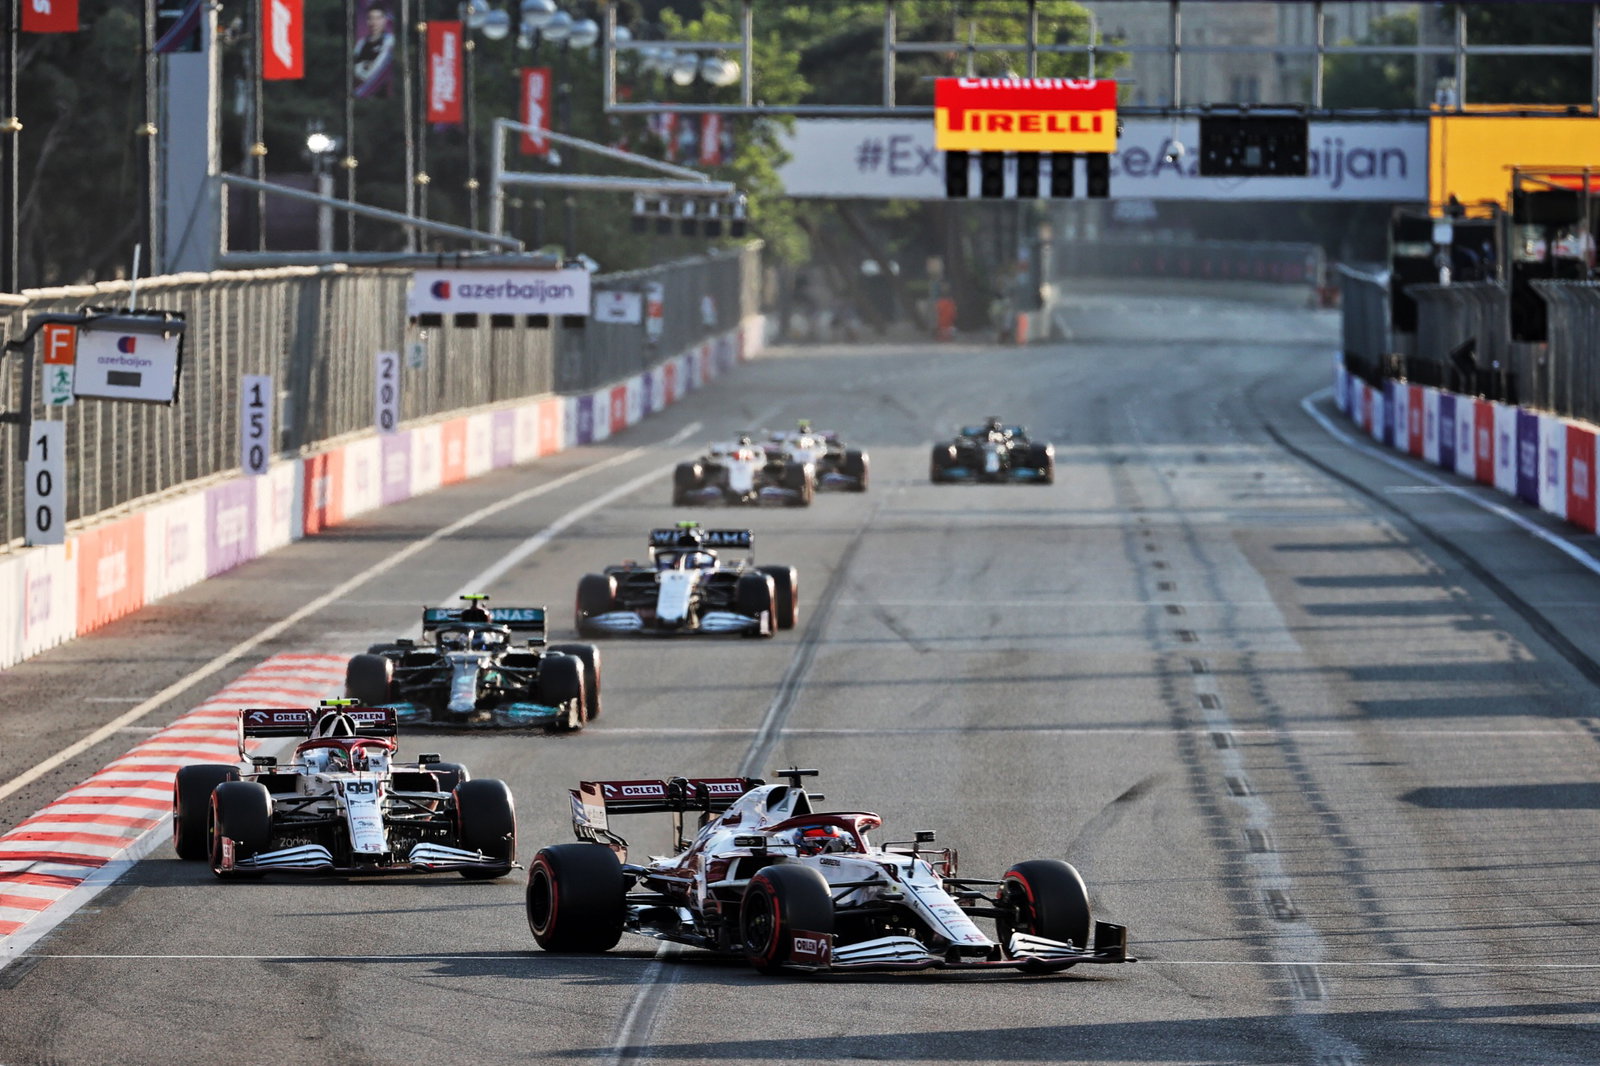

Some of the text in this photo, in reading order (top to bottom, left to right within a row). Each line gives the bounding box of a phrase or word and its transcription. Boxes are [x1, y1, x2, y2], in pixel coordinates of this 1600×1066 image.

[946, 110, 1103, 133] PIRELLI
[458, 280, 575, 303] azerbaijan
[50, 329, 70, 359] F
[97, 356, 152, 368] azerbaijan
[379, 358, 395, 430] 200
[249, 383, 265, 472] 150
[36, 435, 53, 532] 100
[276, 712, 383, 721] ORLEN ORLEN
[624, 786, 661, 795] ORLEN
